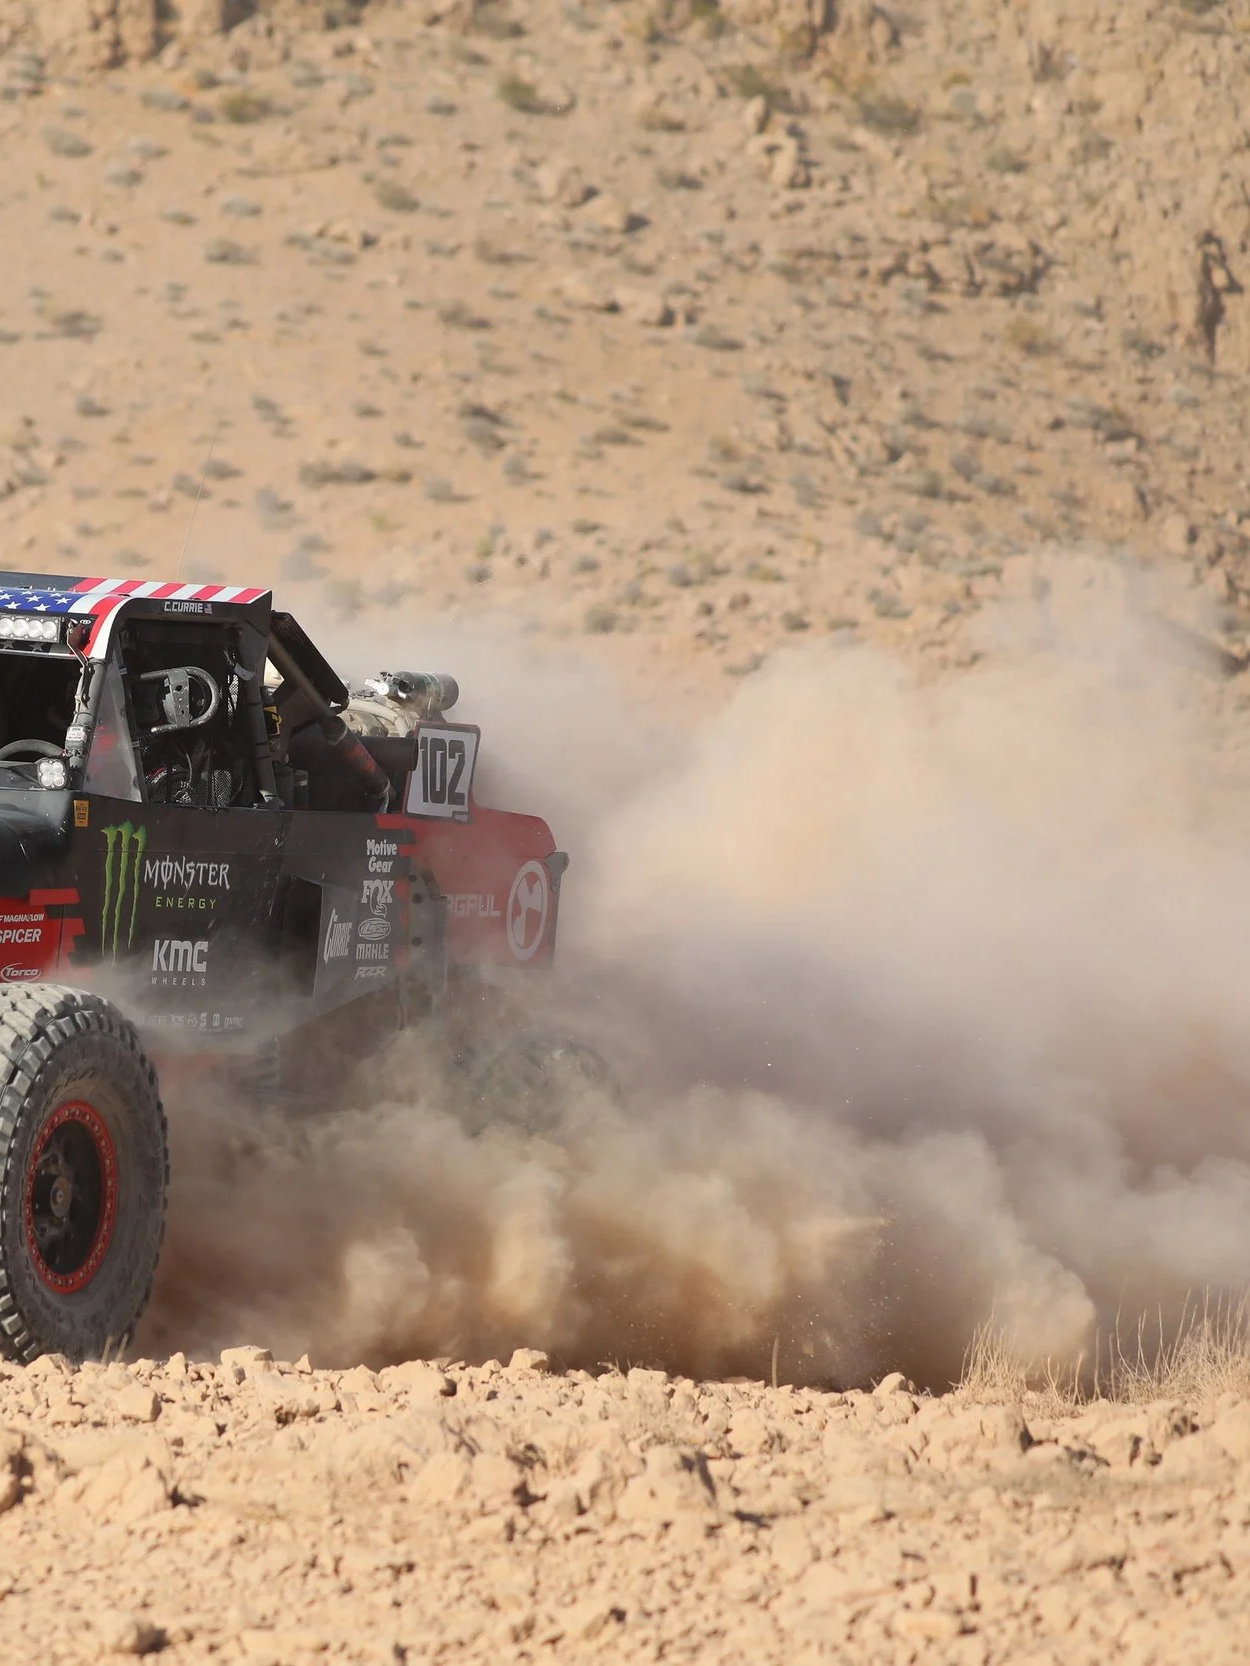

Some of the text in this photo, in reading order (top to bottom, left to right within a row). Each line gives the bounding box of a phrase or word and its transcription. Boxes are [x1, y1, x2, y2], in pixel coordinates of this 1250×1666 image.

[163, 601, 204, 613] C.CURRIE
[419, 736, 466, 806] 102
[366, 839, 398, 856] Motive
[143, 854, 230, 891] MONSTER
[368, 856, 393, 873] Gear
[155, 896, 216, 910] ENERGY
[361, 879, 395, 911] FOX
[152, 939, 209, 973] KMC
[355, 943, 390, 960] MAHLE
[5, 967, 39, 977] Torco
[151, 977, 206, 986] WHEELS
